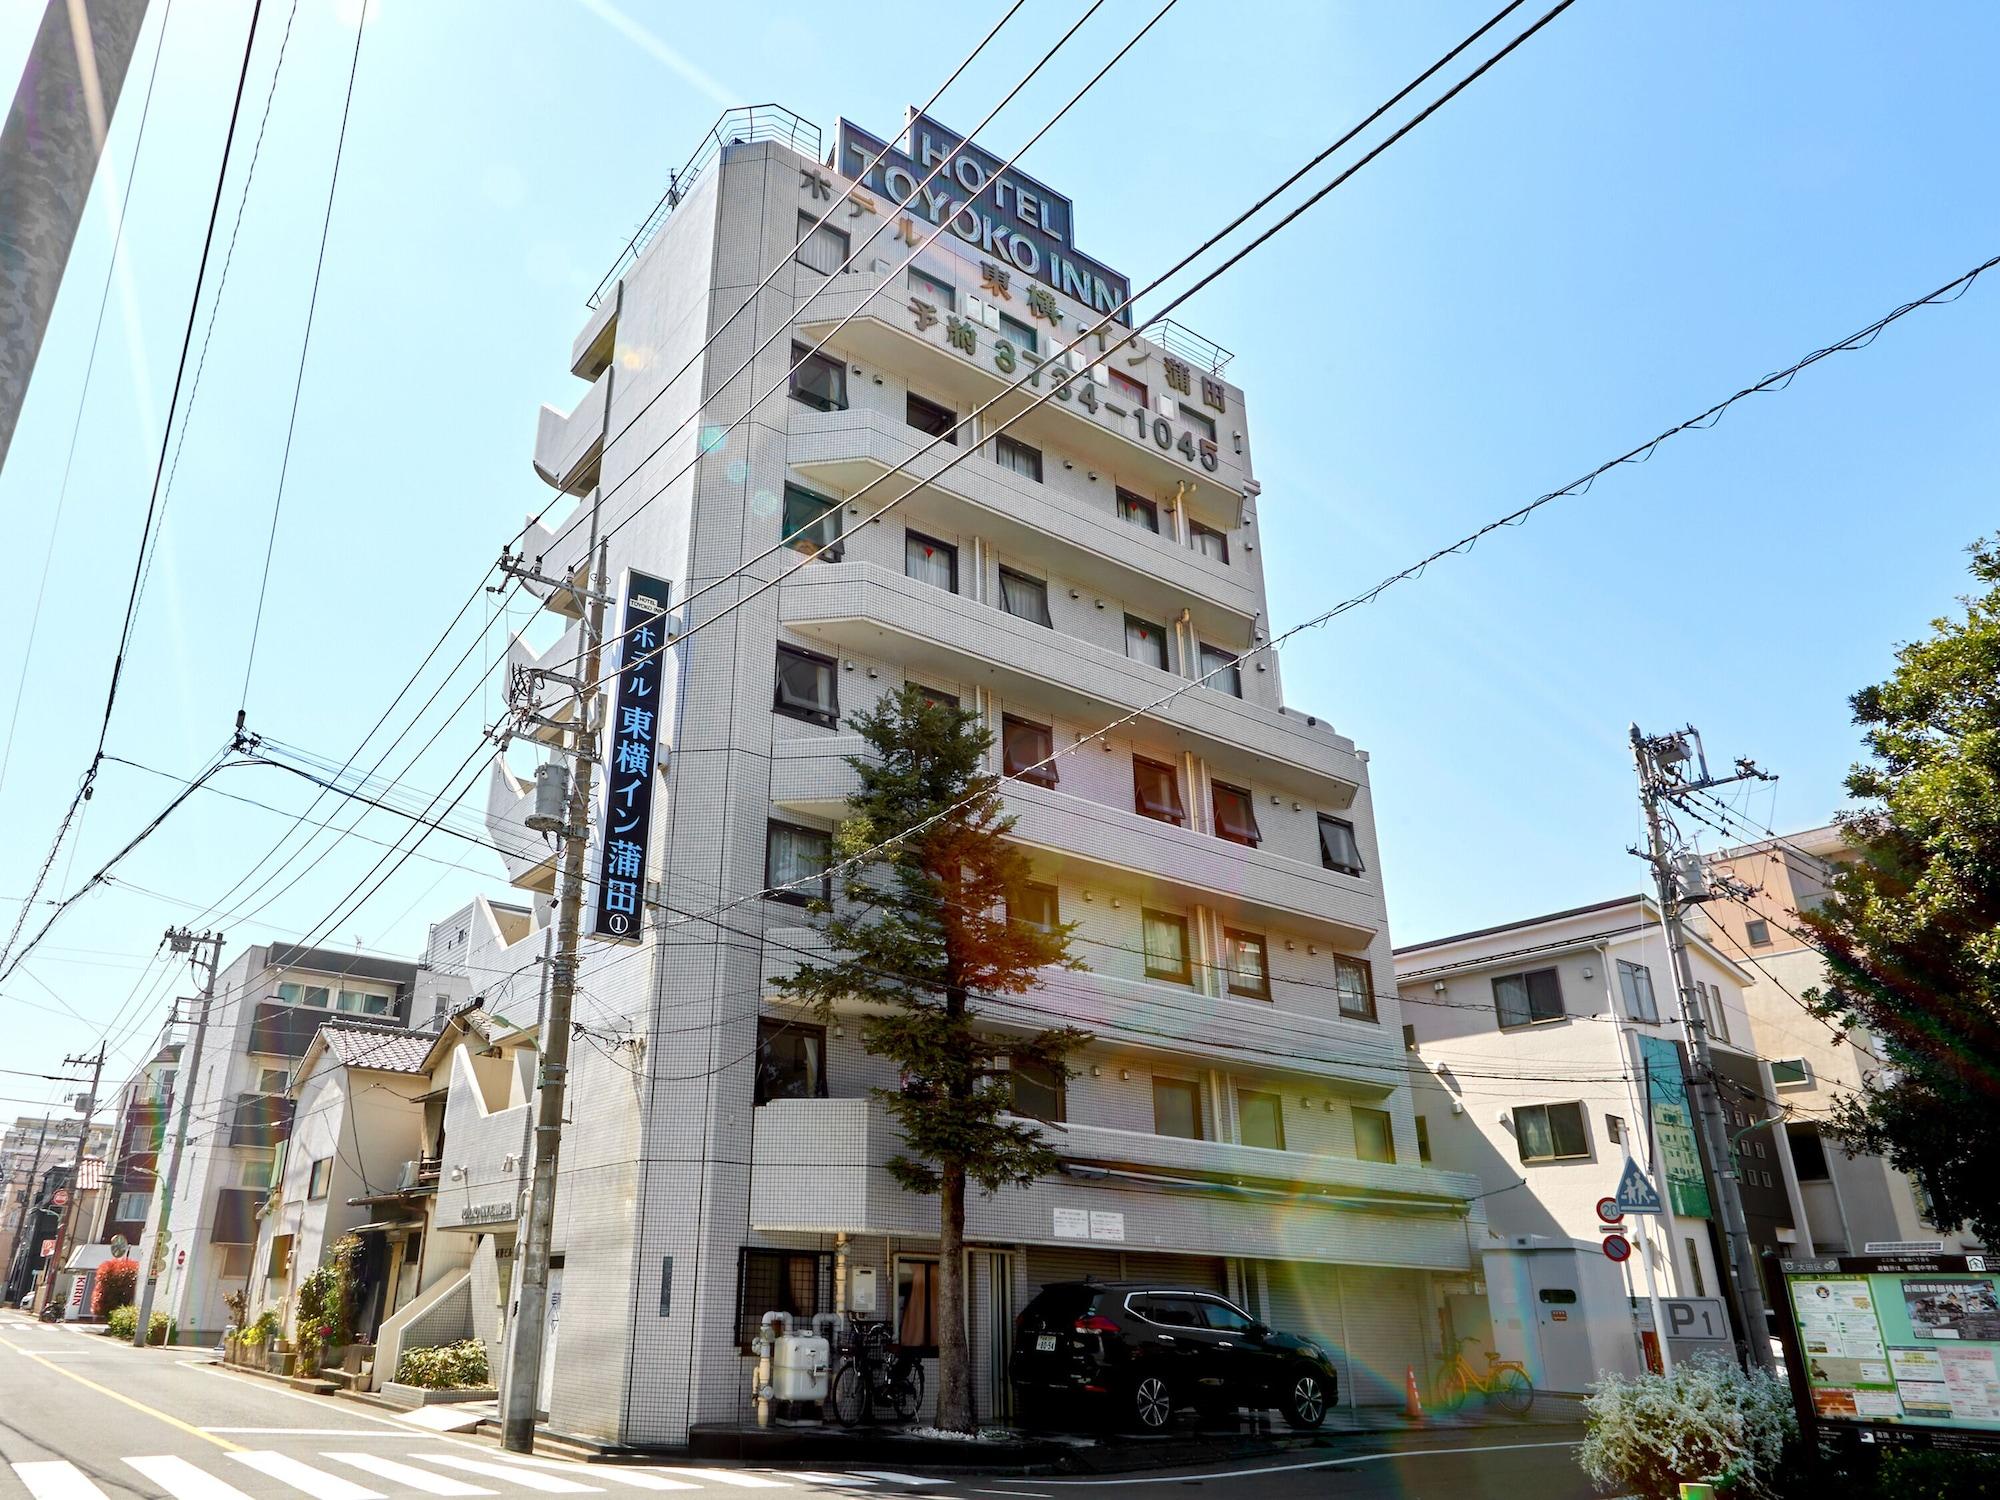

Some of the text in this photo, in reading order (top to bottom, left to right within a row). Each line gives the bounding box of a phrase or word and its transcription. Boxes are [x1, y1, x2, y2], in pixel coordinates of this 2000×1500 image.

[921, 131, 1063, 242] HOTEL
[850, 142, 1125, 321] TOYOKO INN
[639, 597, 656, 605] HOTEL
[1602, 1204, 1618, 1217] 20
[72, 1276, 87, 1306] KIRIN
